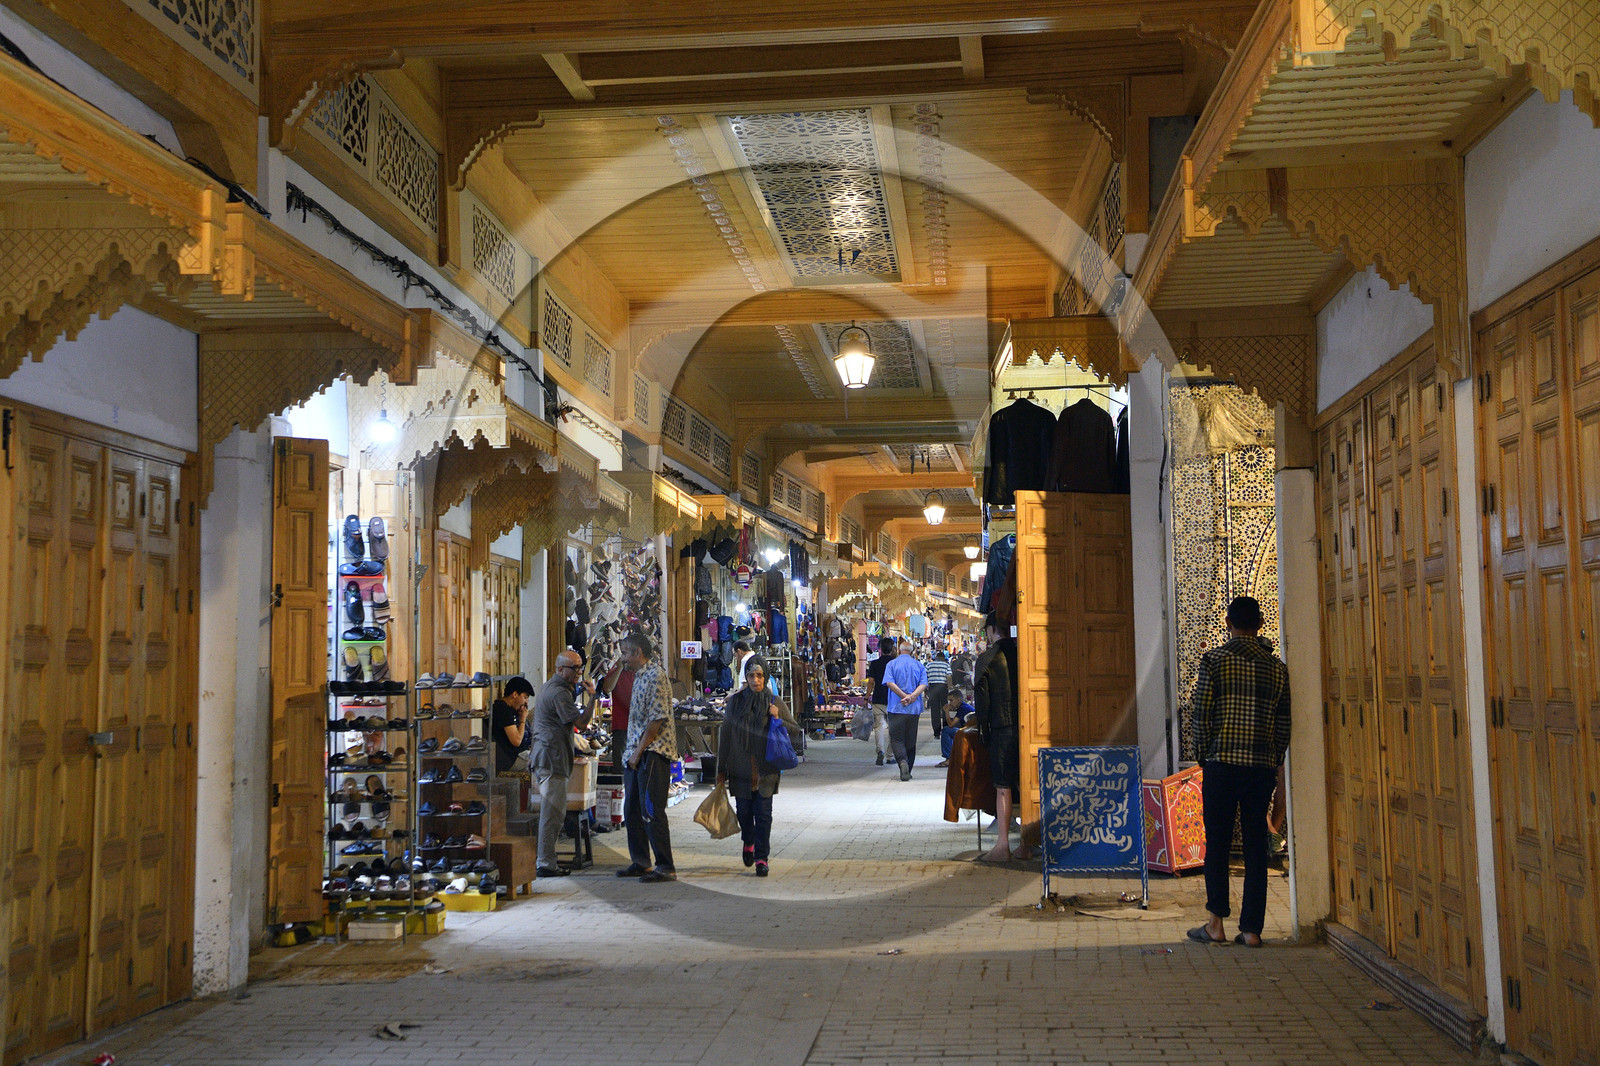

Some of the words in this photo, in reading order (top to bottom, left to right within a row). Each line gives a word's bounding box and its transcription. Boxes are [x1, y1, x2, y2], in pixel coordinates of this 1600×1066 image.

[1099, 756, 1129, 776] هنا
[1046, 772, 1069, 796] جوال
[1068, 776, 1129, 798] السريعة
[1048, 808, 1096, 830] فواتير
[1098, 808, 1129, 828] أداء
